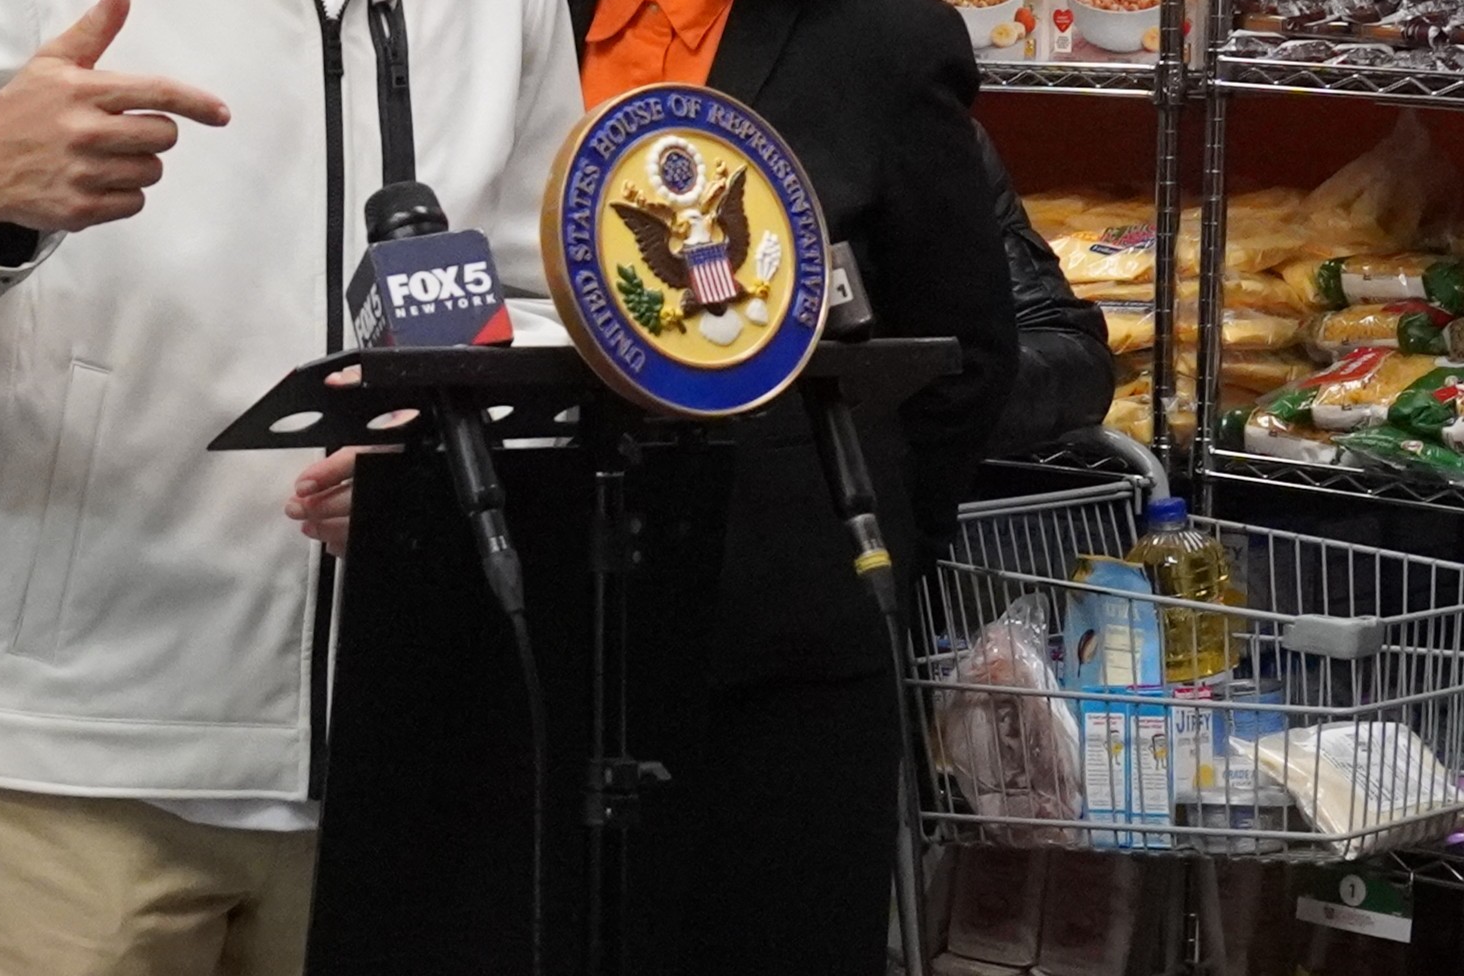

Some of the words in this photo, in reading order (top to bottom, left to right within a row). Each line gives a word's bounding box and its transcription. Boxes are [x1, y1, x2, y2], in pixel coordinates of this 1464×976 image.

[590, 95, 666, 160] HOUSE
[668, 93, 702, 120] OF
[569, 158, 602, 264] STATES
[707, 102, 824, 328] REPRESENTATIVES
[395, 303, 436, 318] NEW
[444, 295, 497, 311] YORK
[577, 269, 648, 374] UNITED
[1348, 882, 1356, 899] 1
